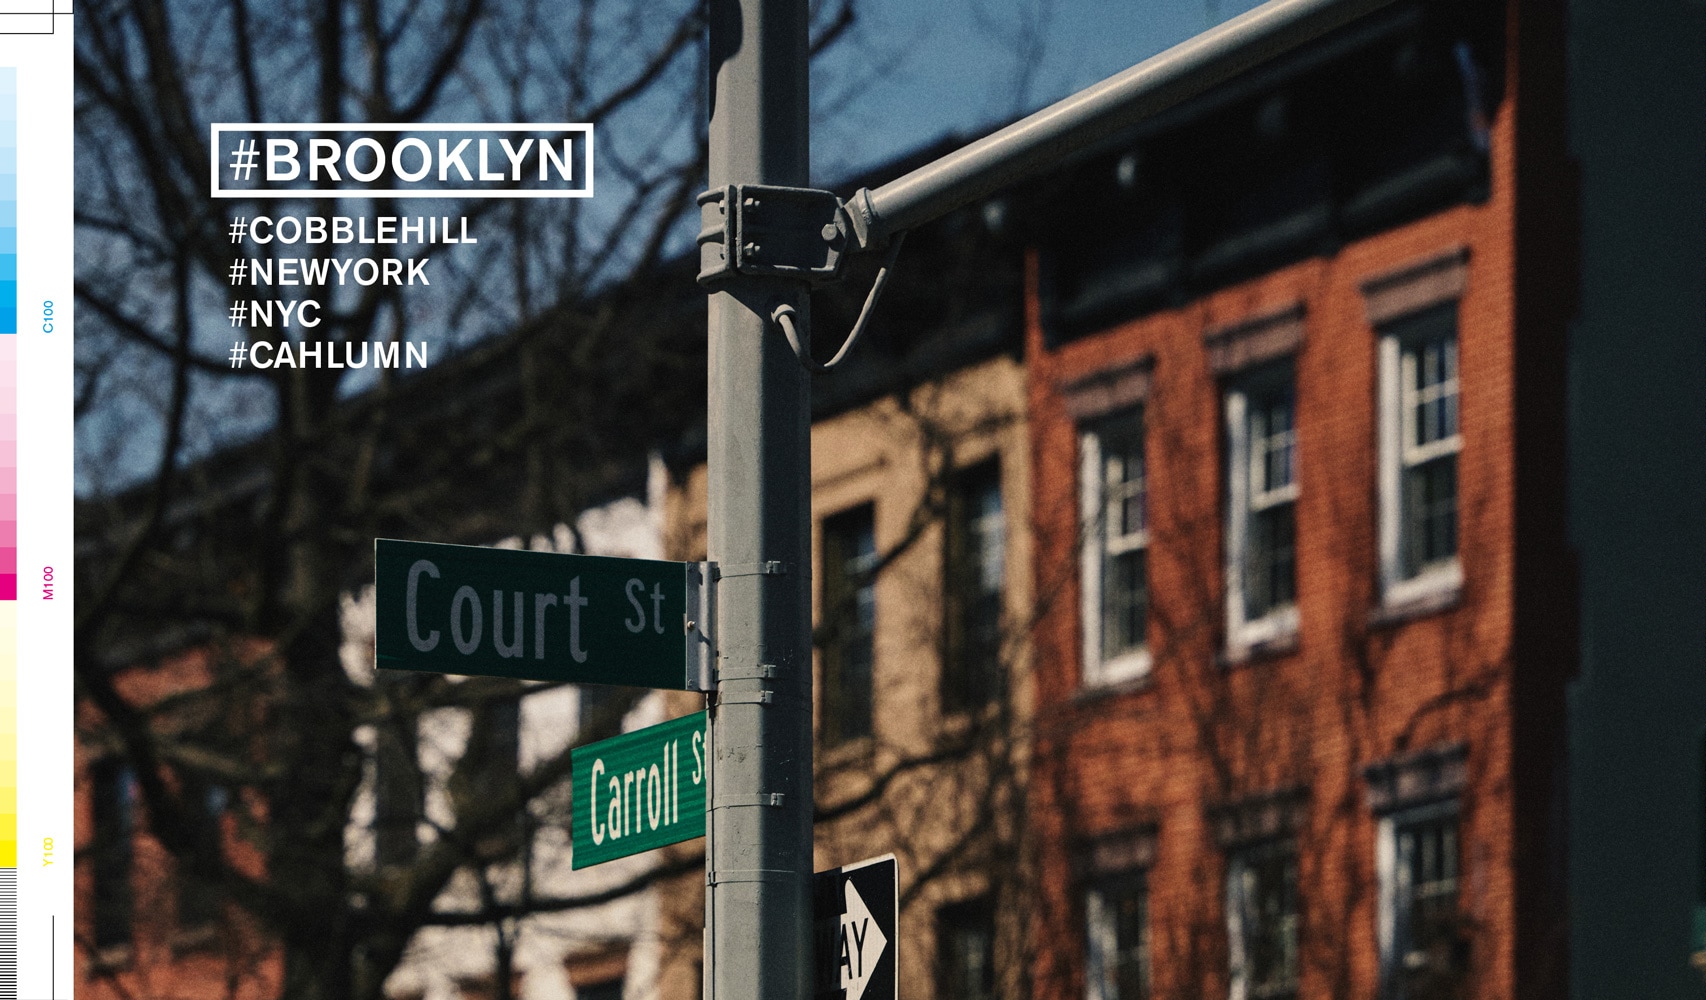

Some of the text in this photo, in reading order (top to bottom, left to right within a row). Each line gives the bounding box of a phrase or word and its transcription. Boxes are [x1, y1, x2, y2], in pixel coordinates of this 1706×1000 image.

[406, 559, 666, 664] Court St
[590, 738, 679, 846] Carroll
